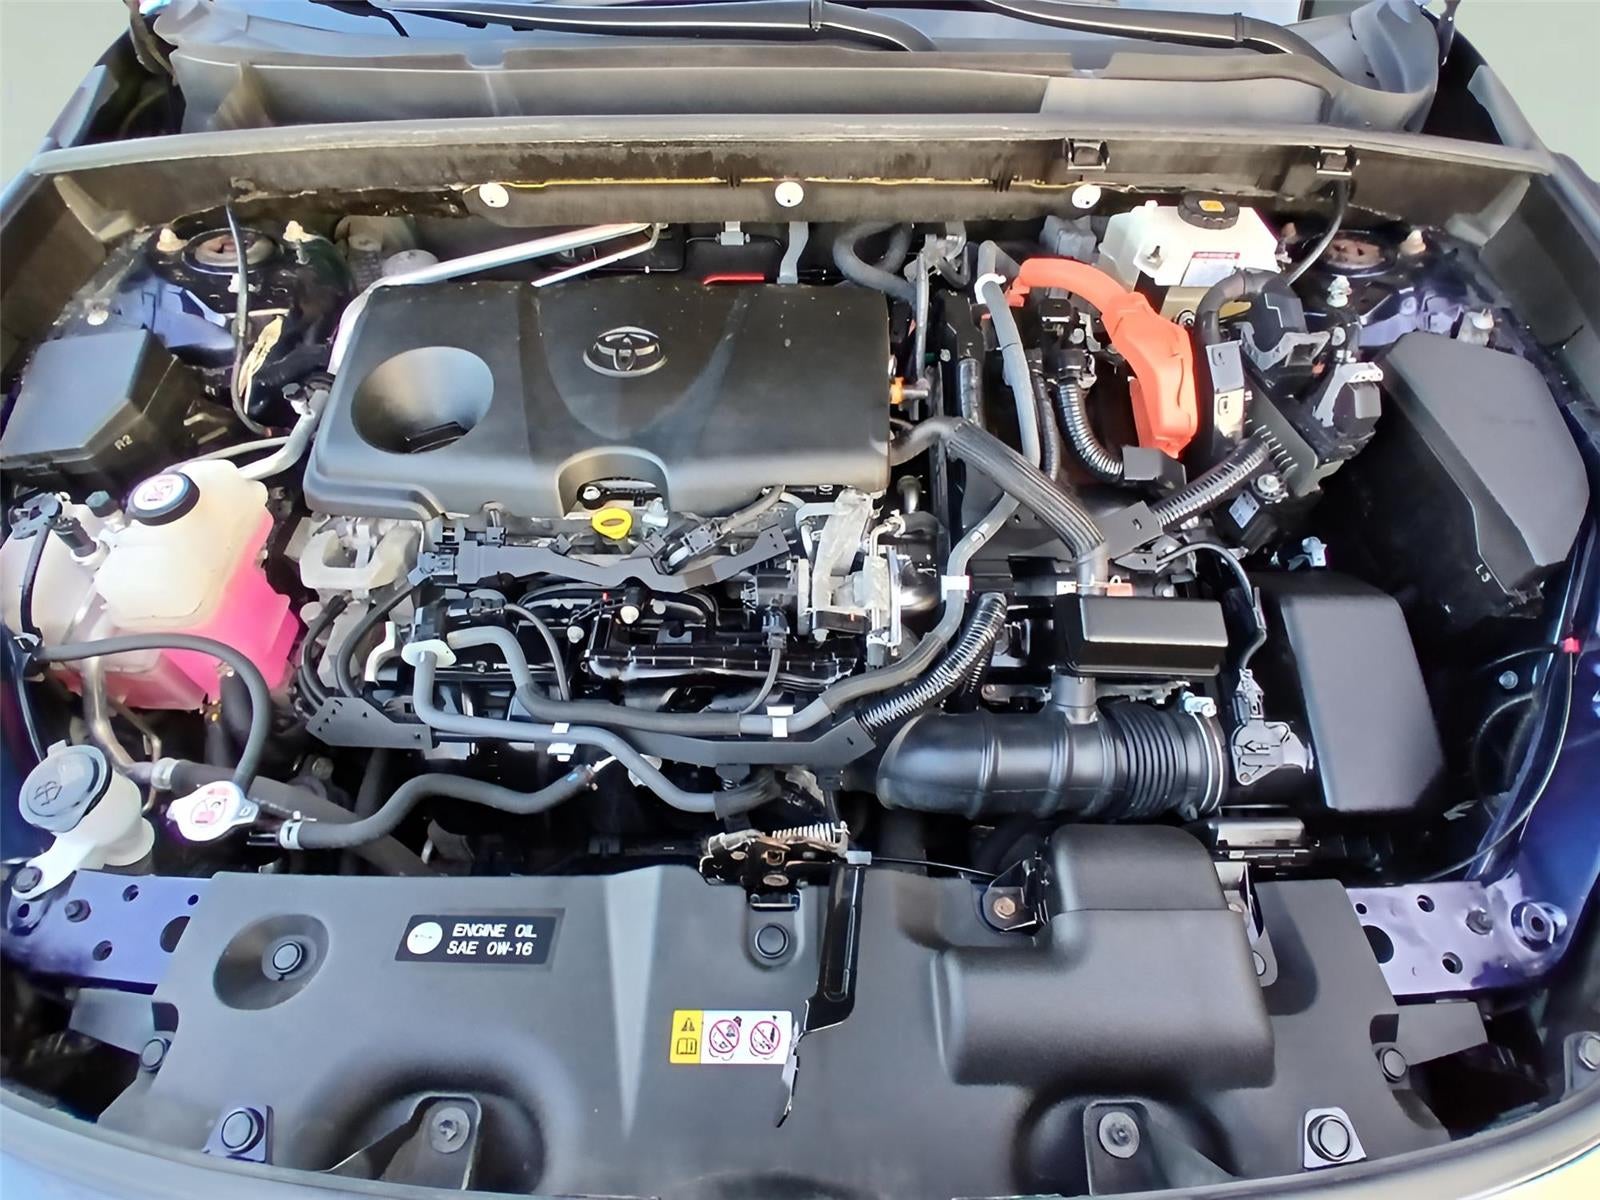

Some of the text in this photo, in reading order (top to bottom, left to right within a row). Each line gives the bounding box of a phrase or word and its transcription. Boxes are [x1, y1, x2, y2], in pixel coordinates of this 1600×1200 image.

[114, 434, 133, 450] R2
[452, 923, 537, 938] ENGINE OIL
[446, 940, 533, 956] SAE 0W-16
